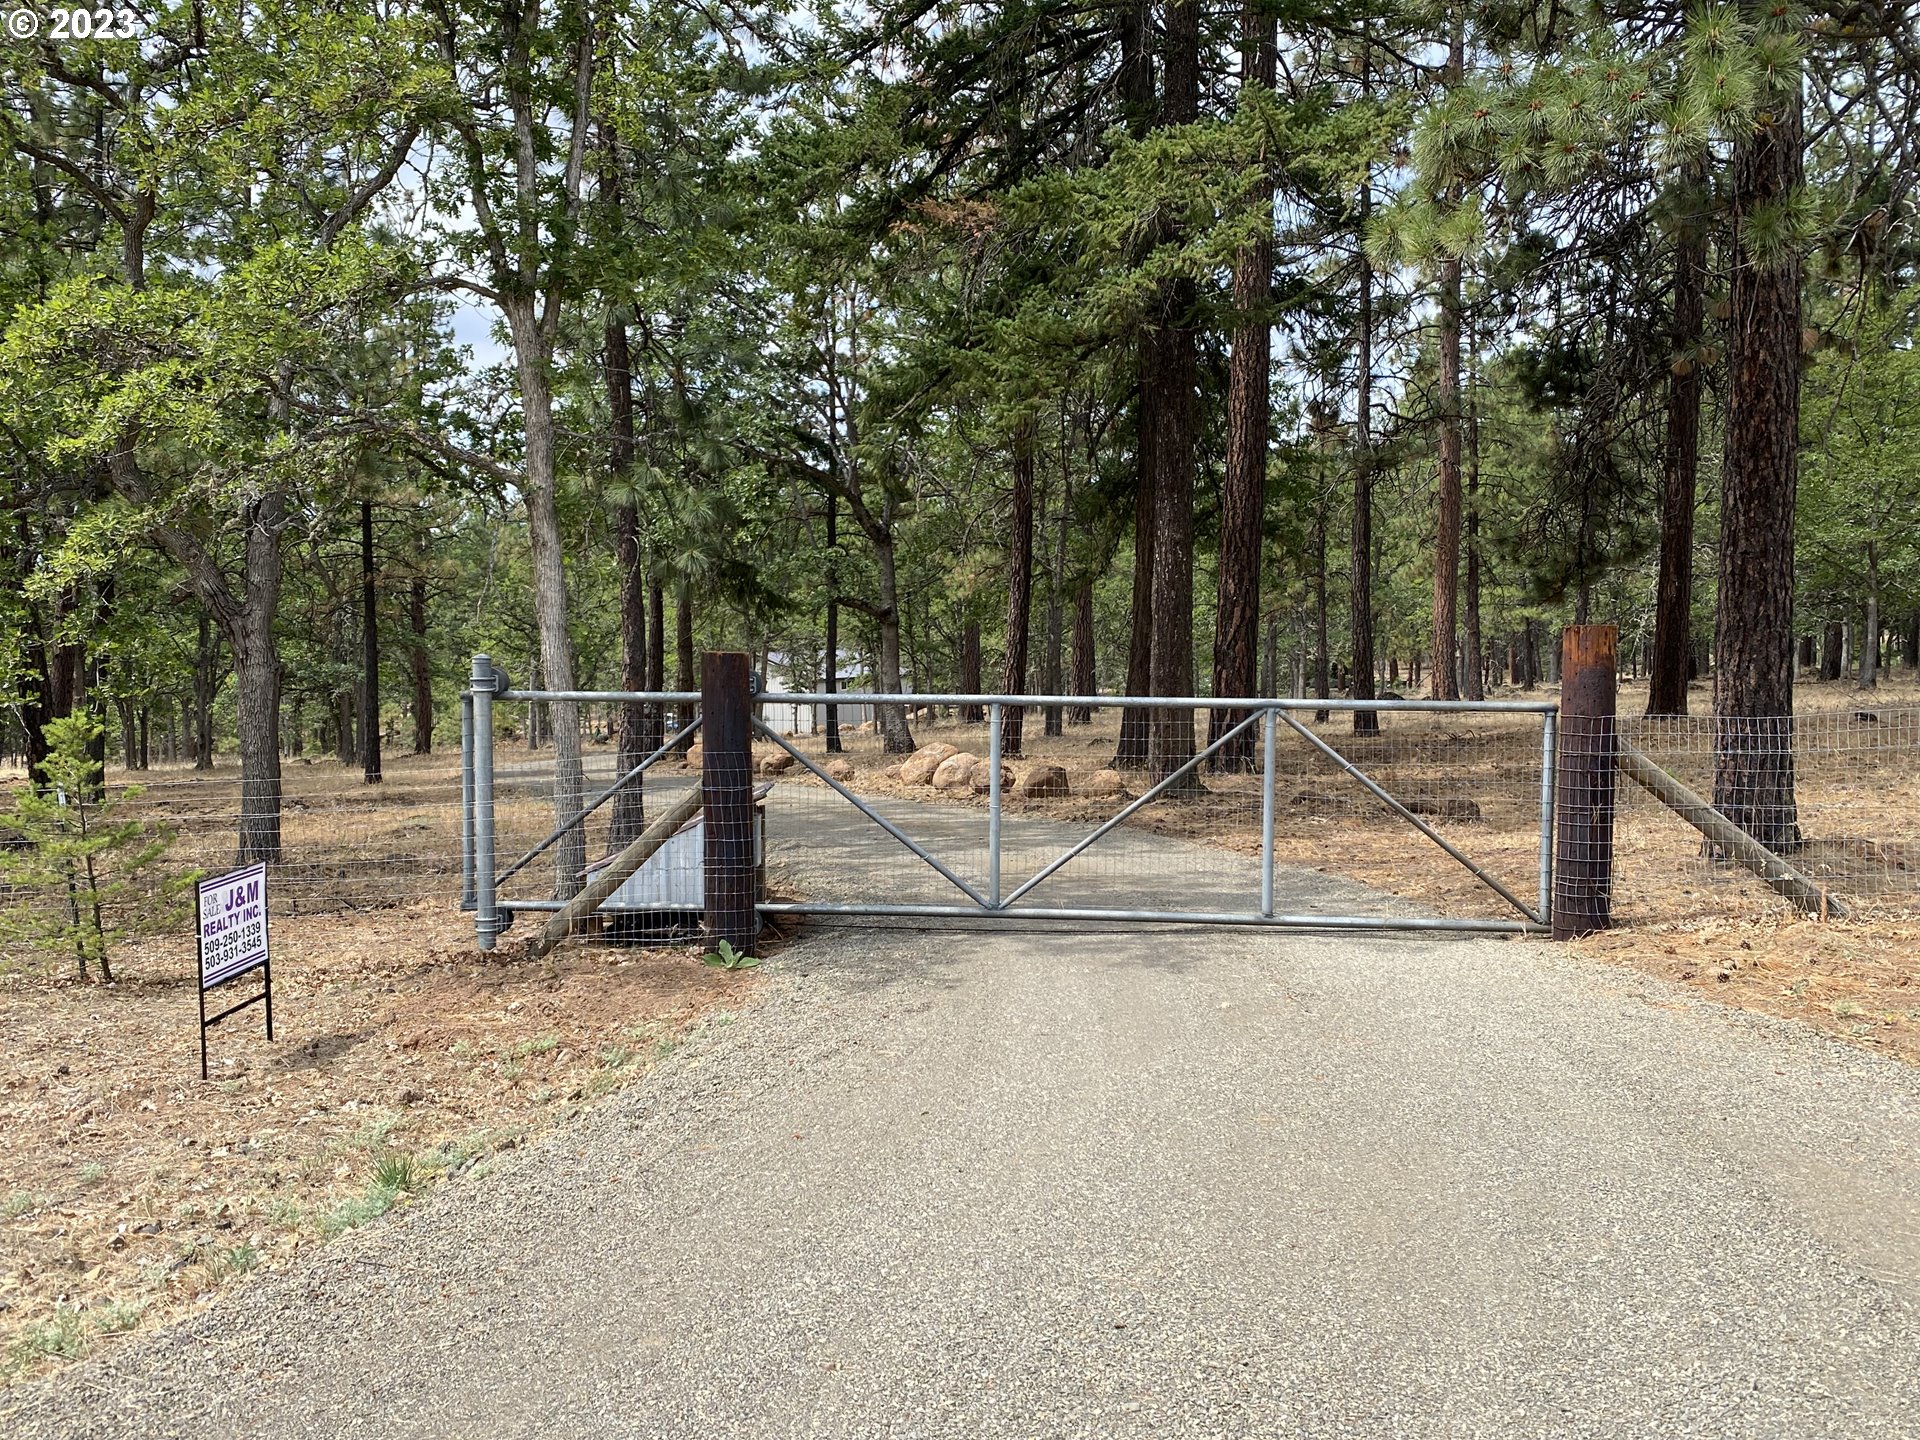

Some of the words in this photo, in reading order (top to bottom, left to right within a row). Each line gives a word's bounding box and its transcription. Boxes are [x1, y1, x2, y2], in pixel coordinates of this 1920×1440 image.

[202, 904, 221, 920] SALE
[203, 893, 218, 907] FOR
[225, 880, 259, 912] J&M
[203, 911, 240, 938] REALTY
[243, 904, 261, 922] INC.
[204, 921, 261, 955] 509-250-1339
[205, 935, 262, 970] 503-931-3545
